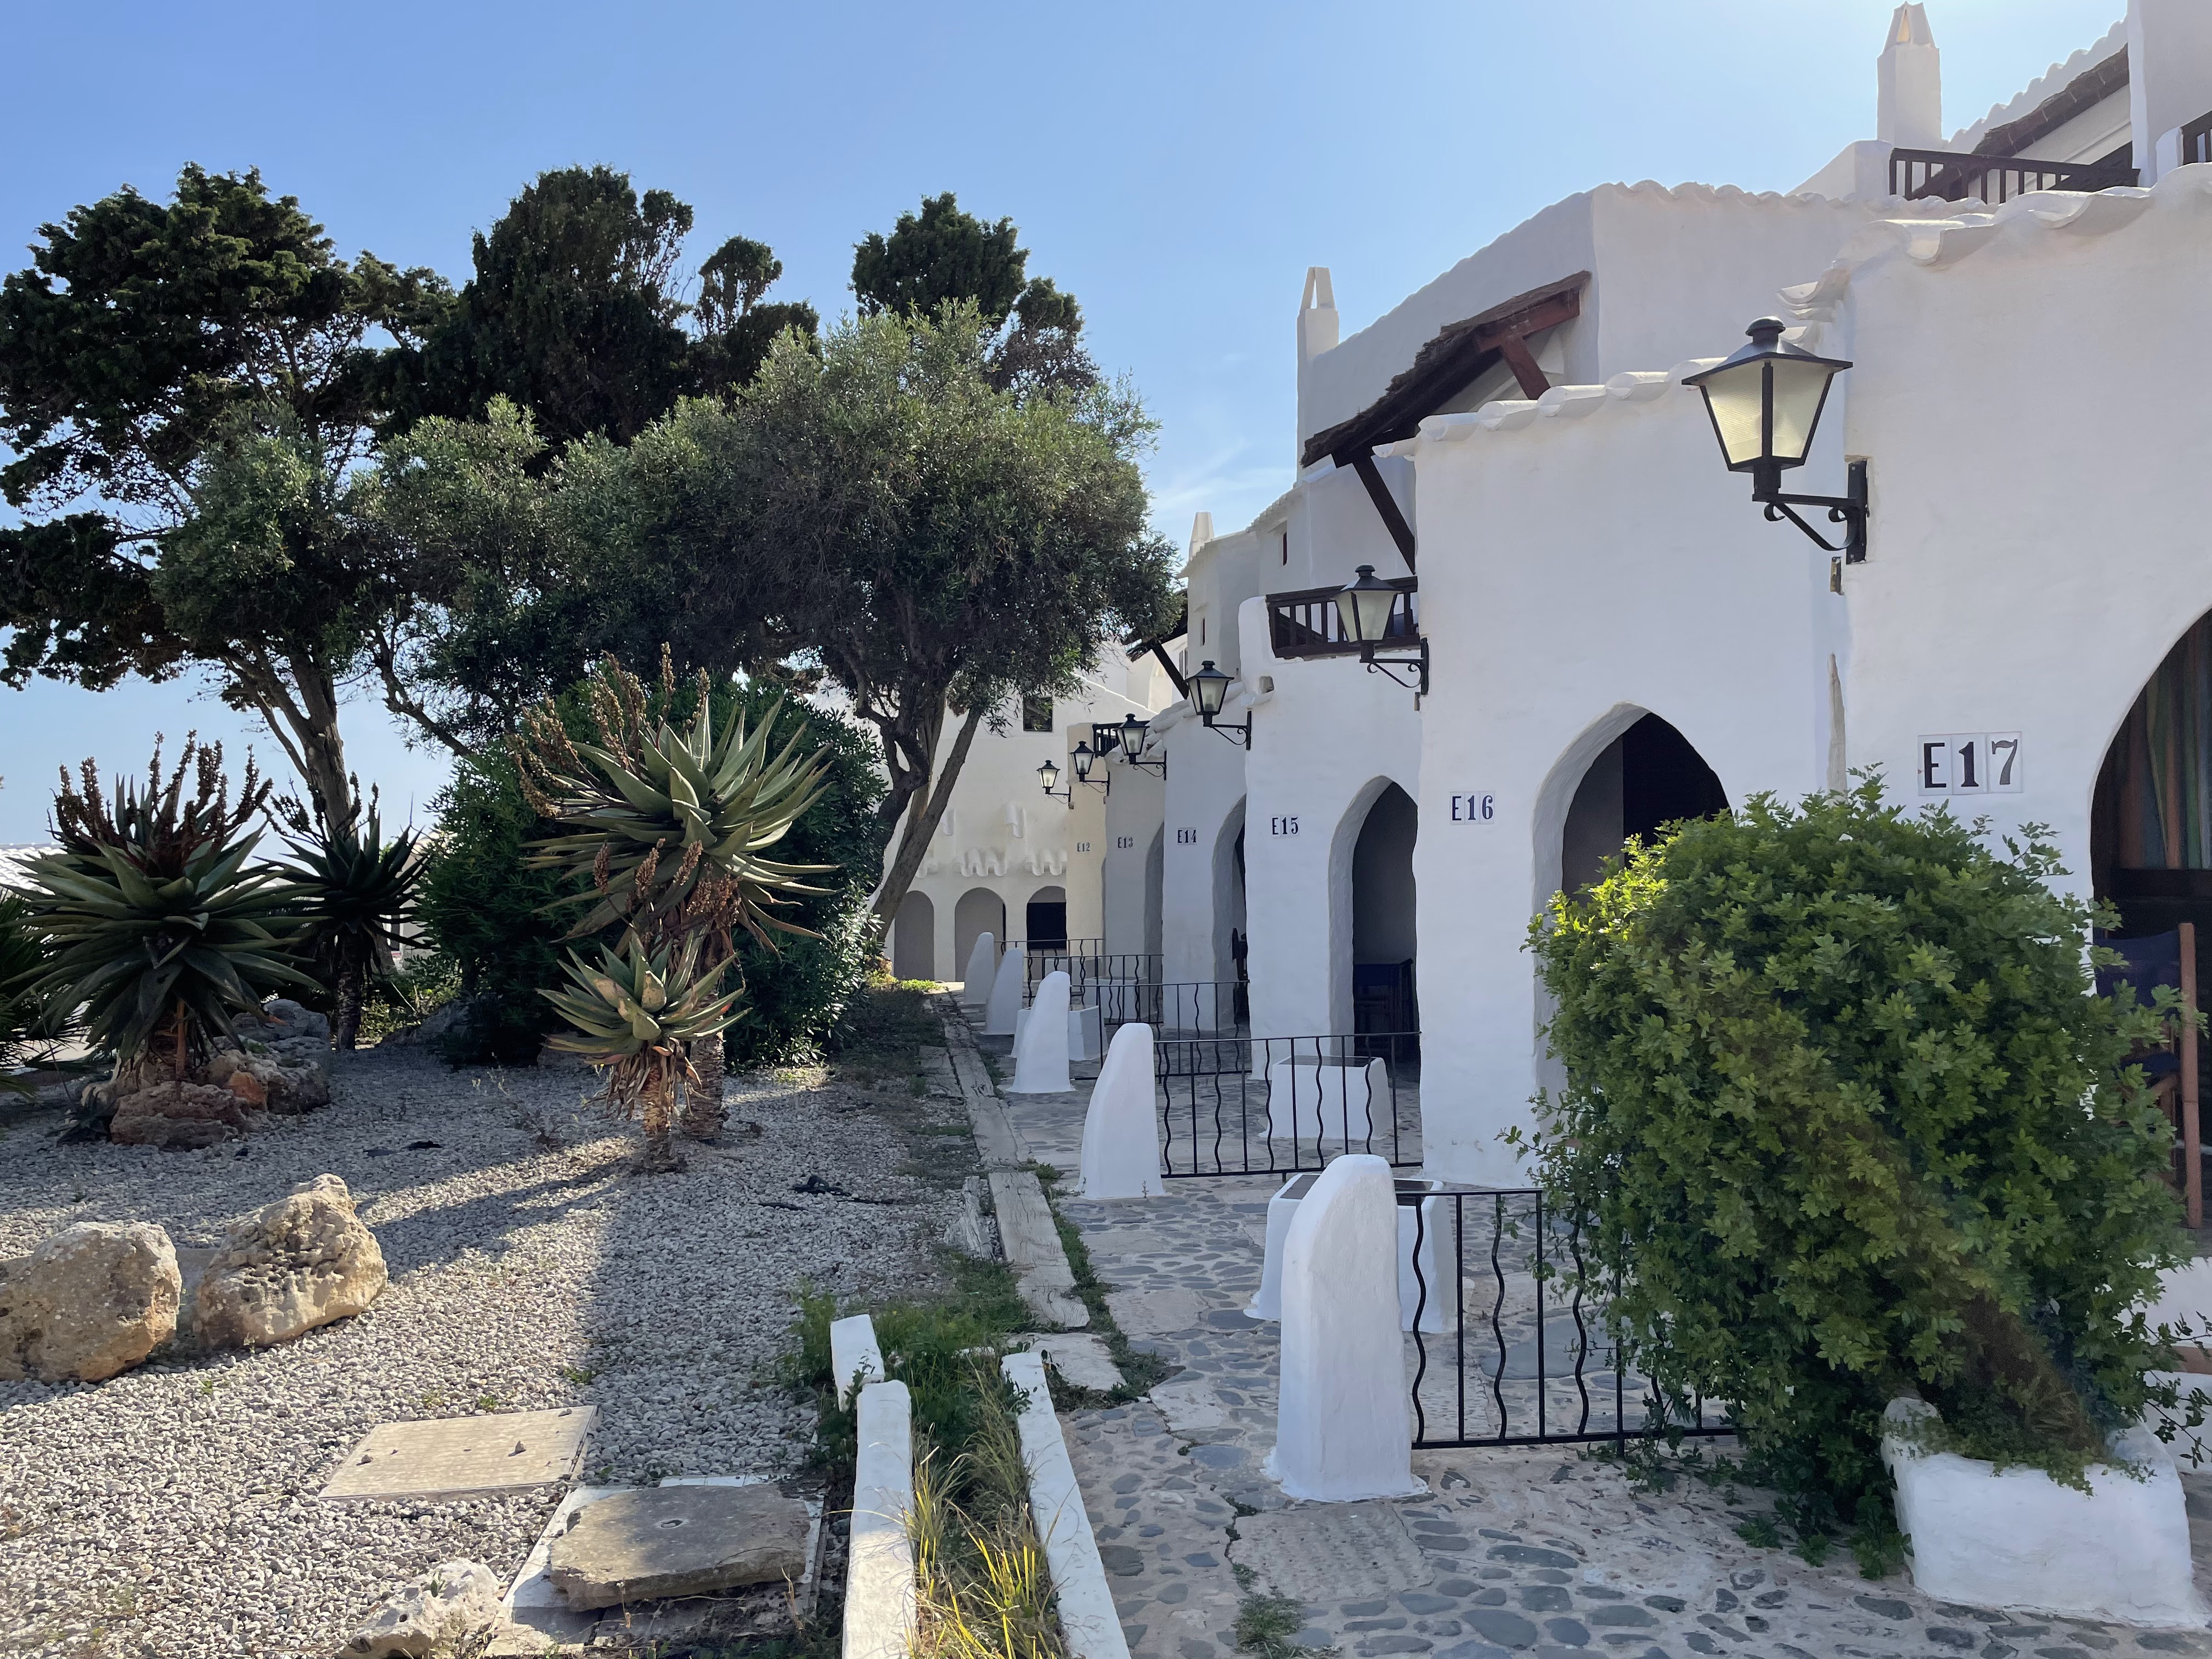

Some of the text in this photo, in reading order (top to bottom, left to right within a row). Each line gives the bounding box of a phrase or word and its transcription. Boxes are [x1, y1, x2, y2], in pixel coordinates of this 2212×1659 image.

[1923, 739, 2018, 789] E17
[1452, 795, 1494, 821] E16
[1272, 816, 1299, 835] E15
[1118, 837, 1133, 848] E13
[1177, 830, 1197, 843] E14
[1077, 842, 1090, 852] E12
